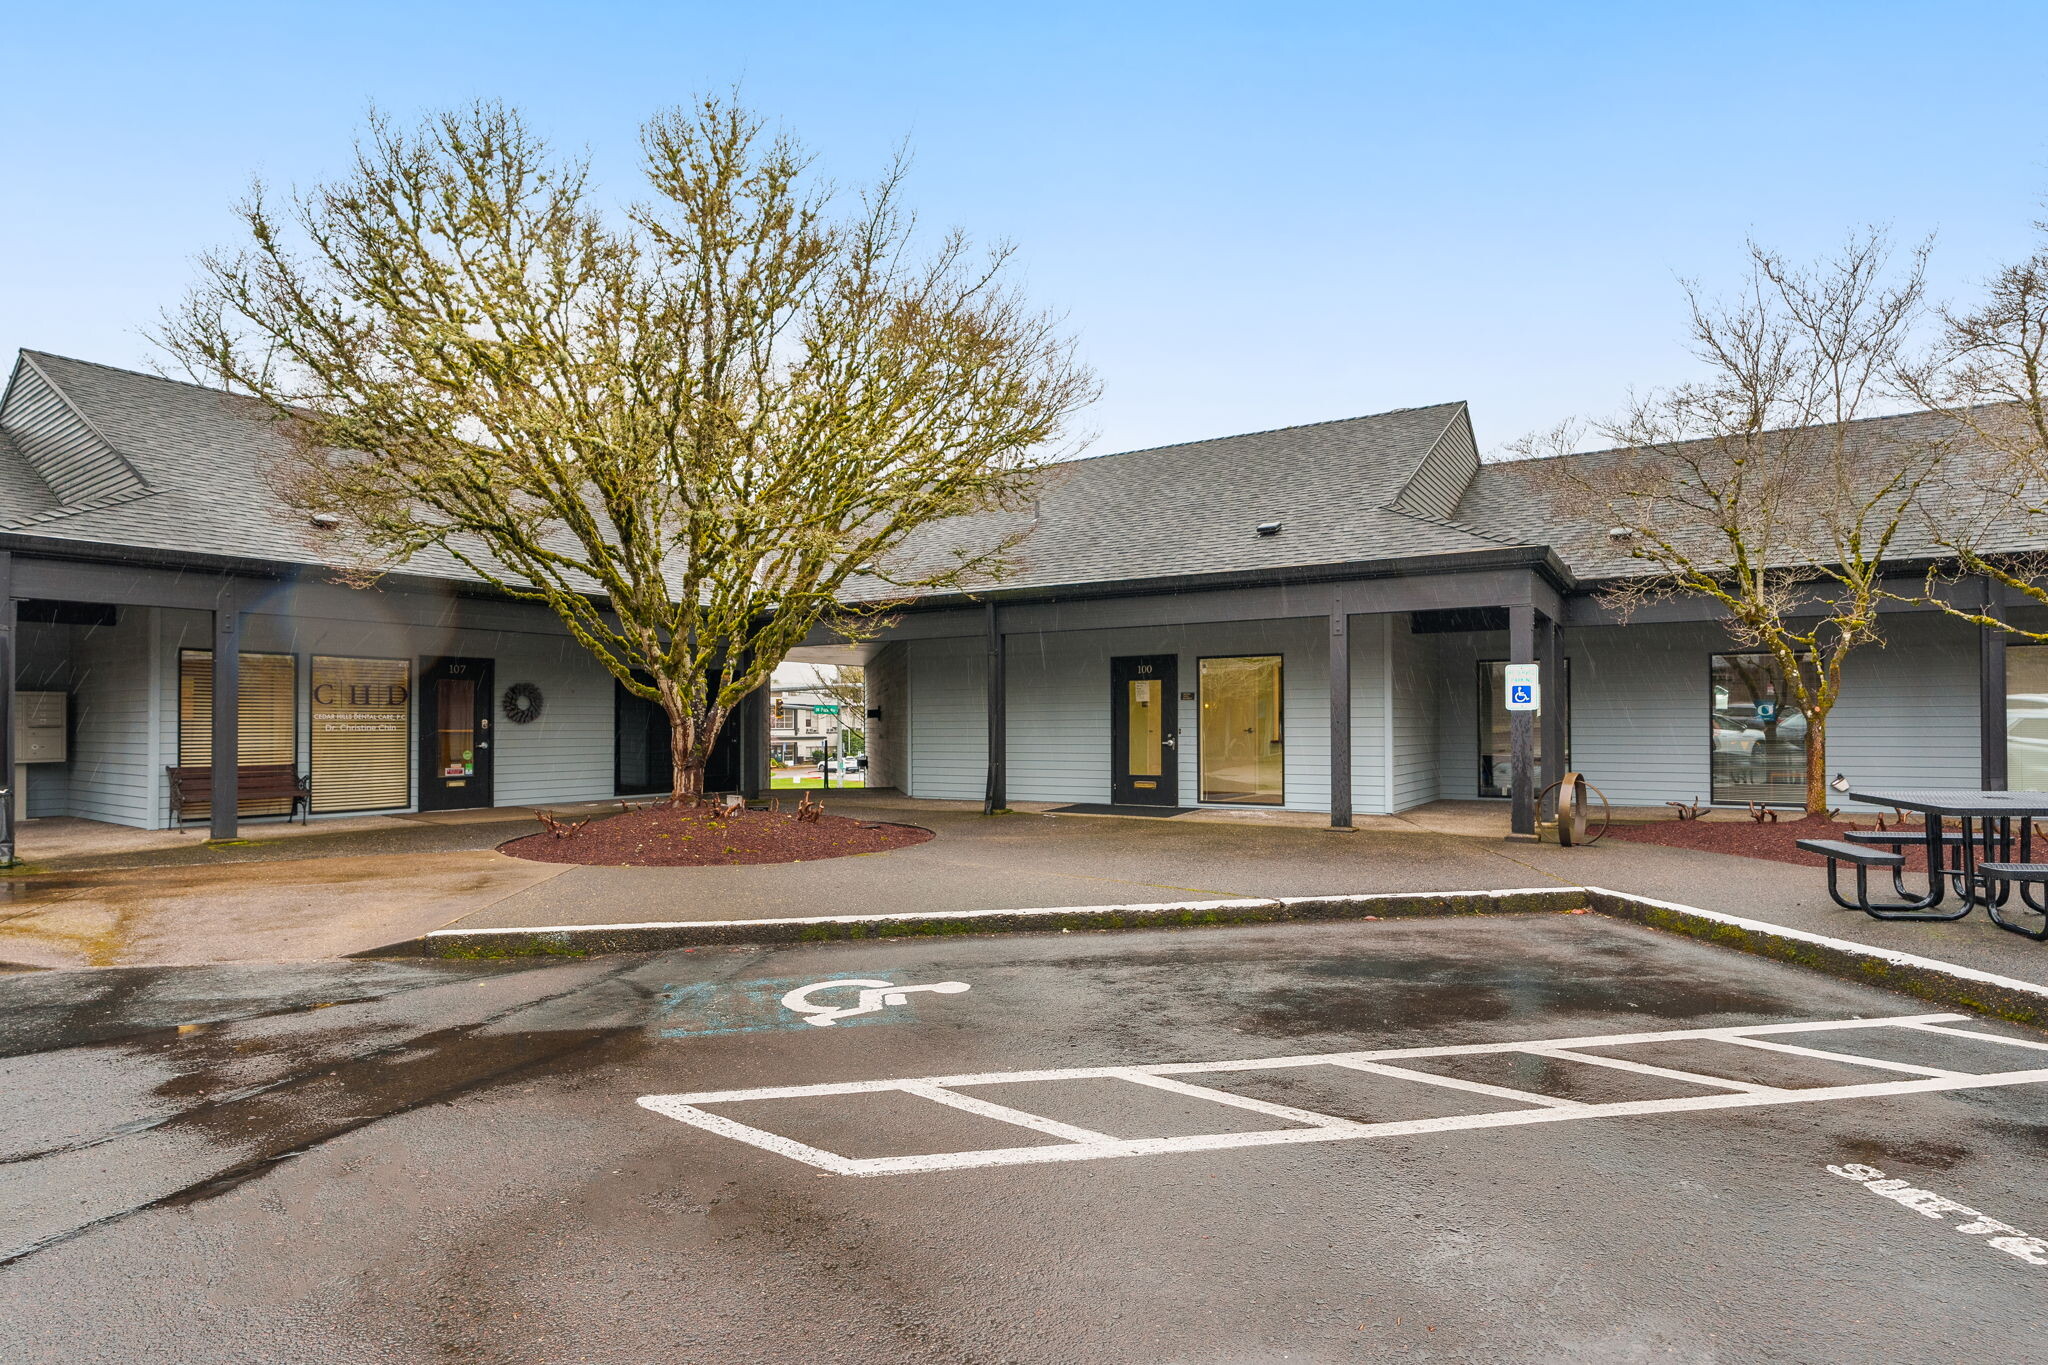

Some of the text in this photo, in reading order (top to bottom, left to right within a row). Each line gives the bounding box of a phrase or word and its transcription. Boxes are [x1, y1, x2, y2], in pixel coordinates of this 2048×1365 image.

[449, 665, 466, 674] 107
[1138, 665, 1152, 674] 100
[340, 724, 376, 732] Christine
[379, 724, 397, 732] Chin
